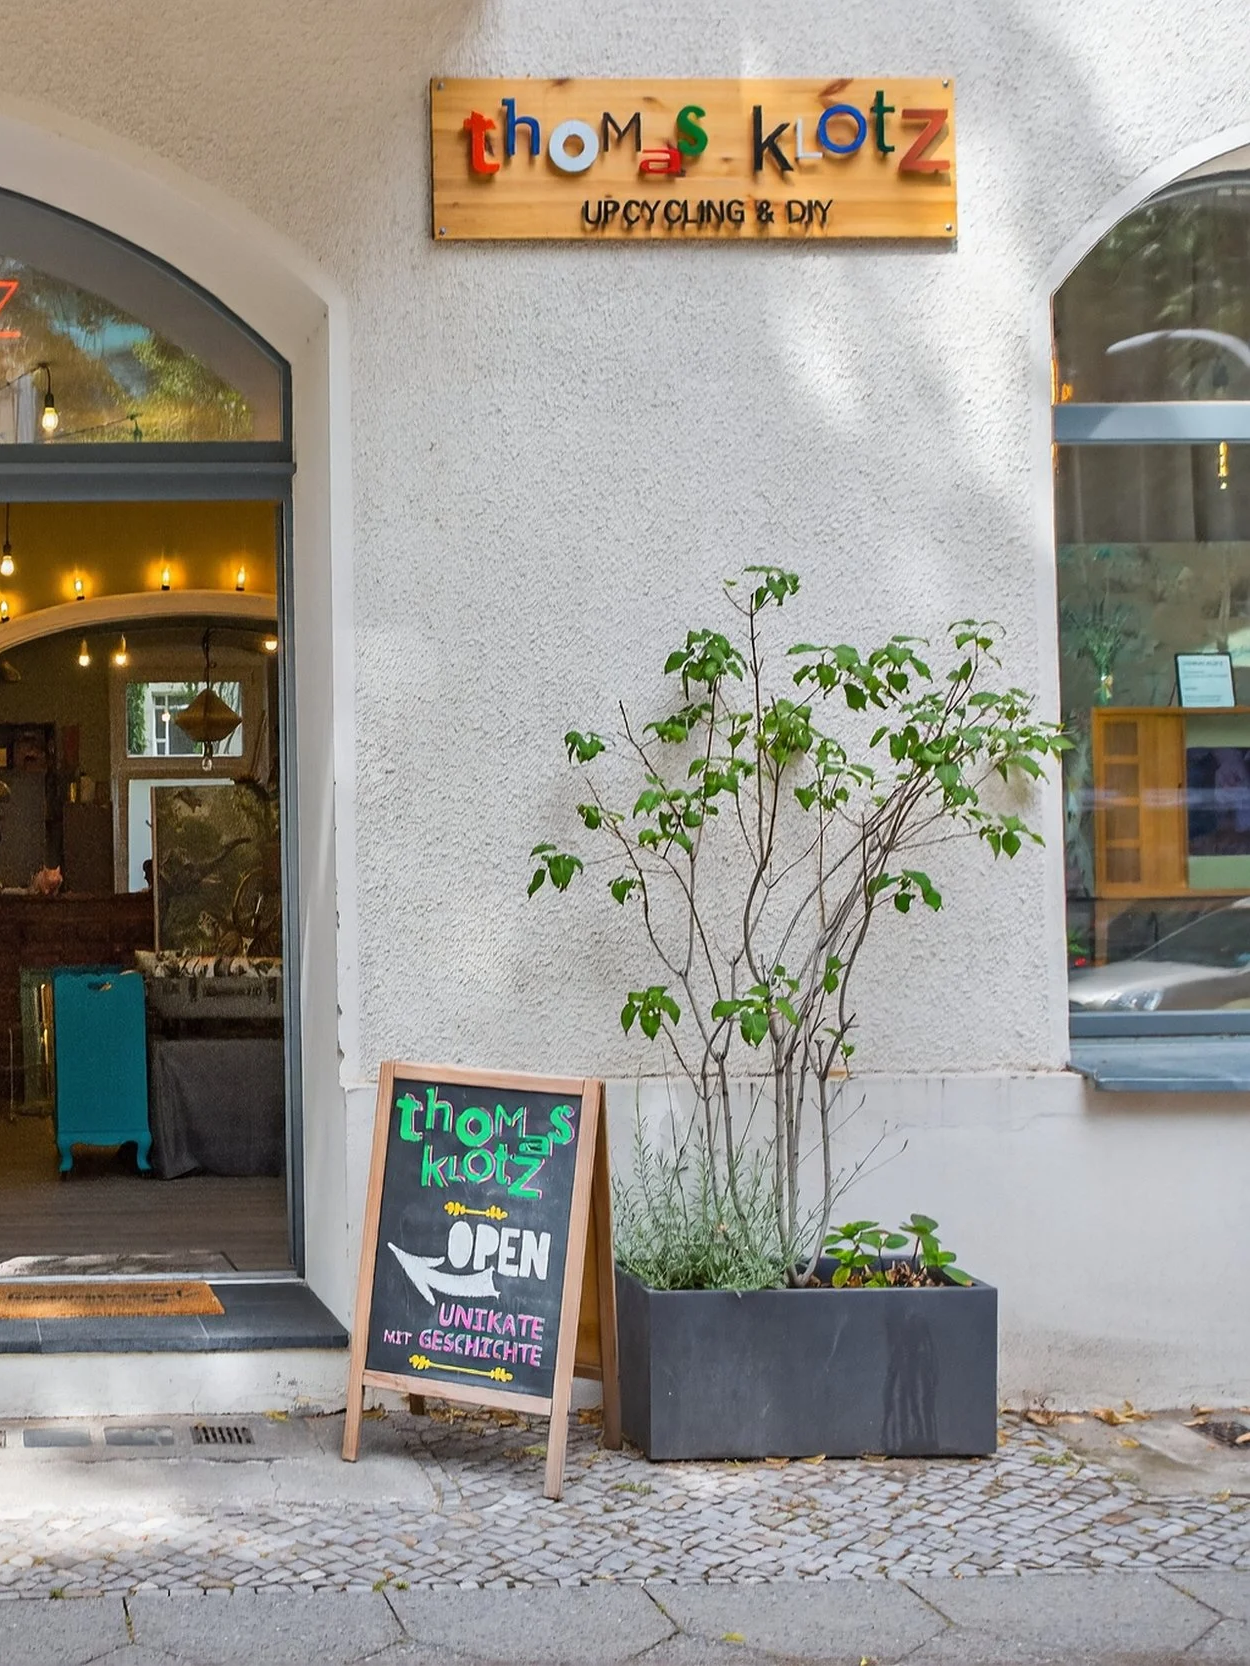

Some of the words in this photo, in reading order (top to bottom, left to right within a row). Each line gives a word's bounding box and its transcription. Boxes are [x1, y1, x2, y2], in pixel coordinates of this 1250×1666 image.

[583, 199, 745, 226] UPCYCLING
[757, 199, 775, 224] &
[786, 199, 833, 226] DIY
[448, 1220, 551, 1280] OPEN
[438, 1302, 546, 1341] UNIKATE
[383, 1329, 413, 1346] MIT
[418, 1328, 543, 1368] GESCHICHTE
